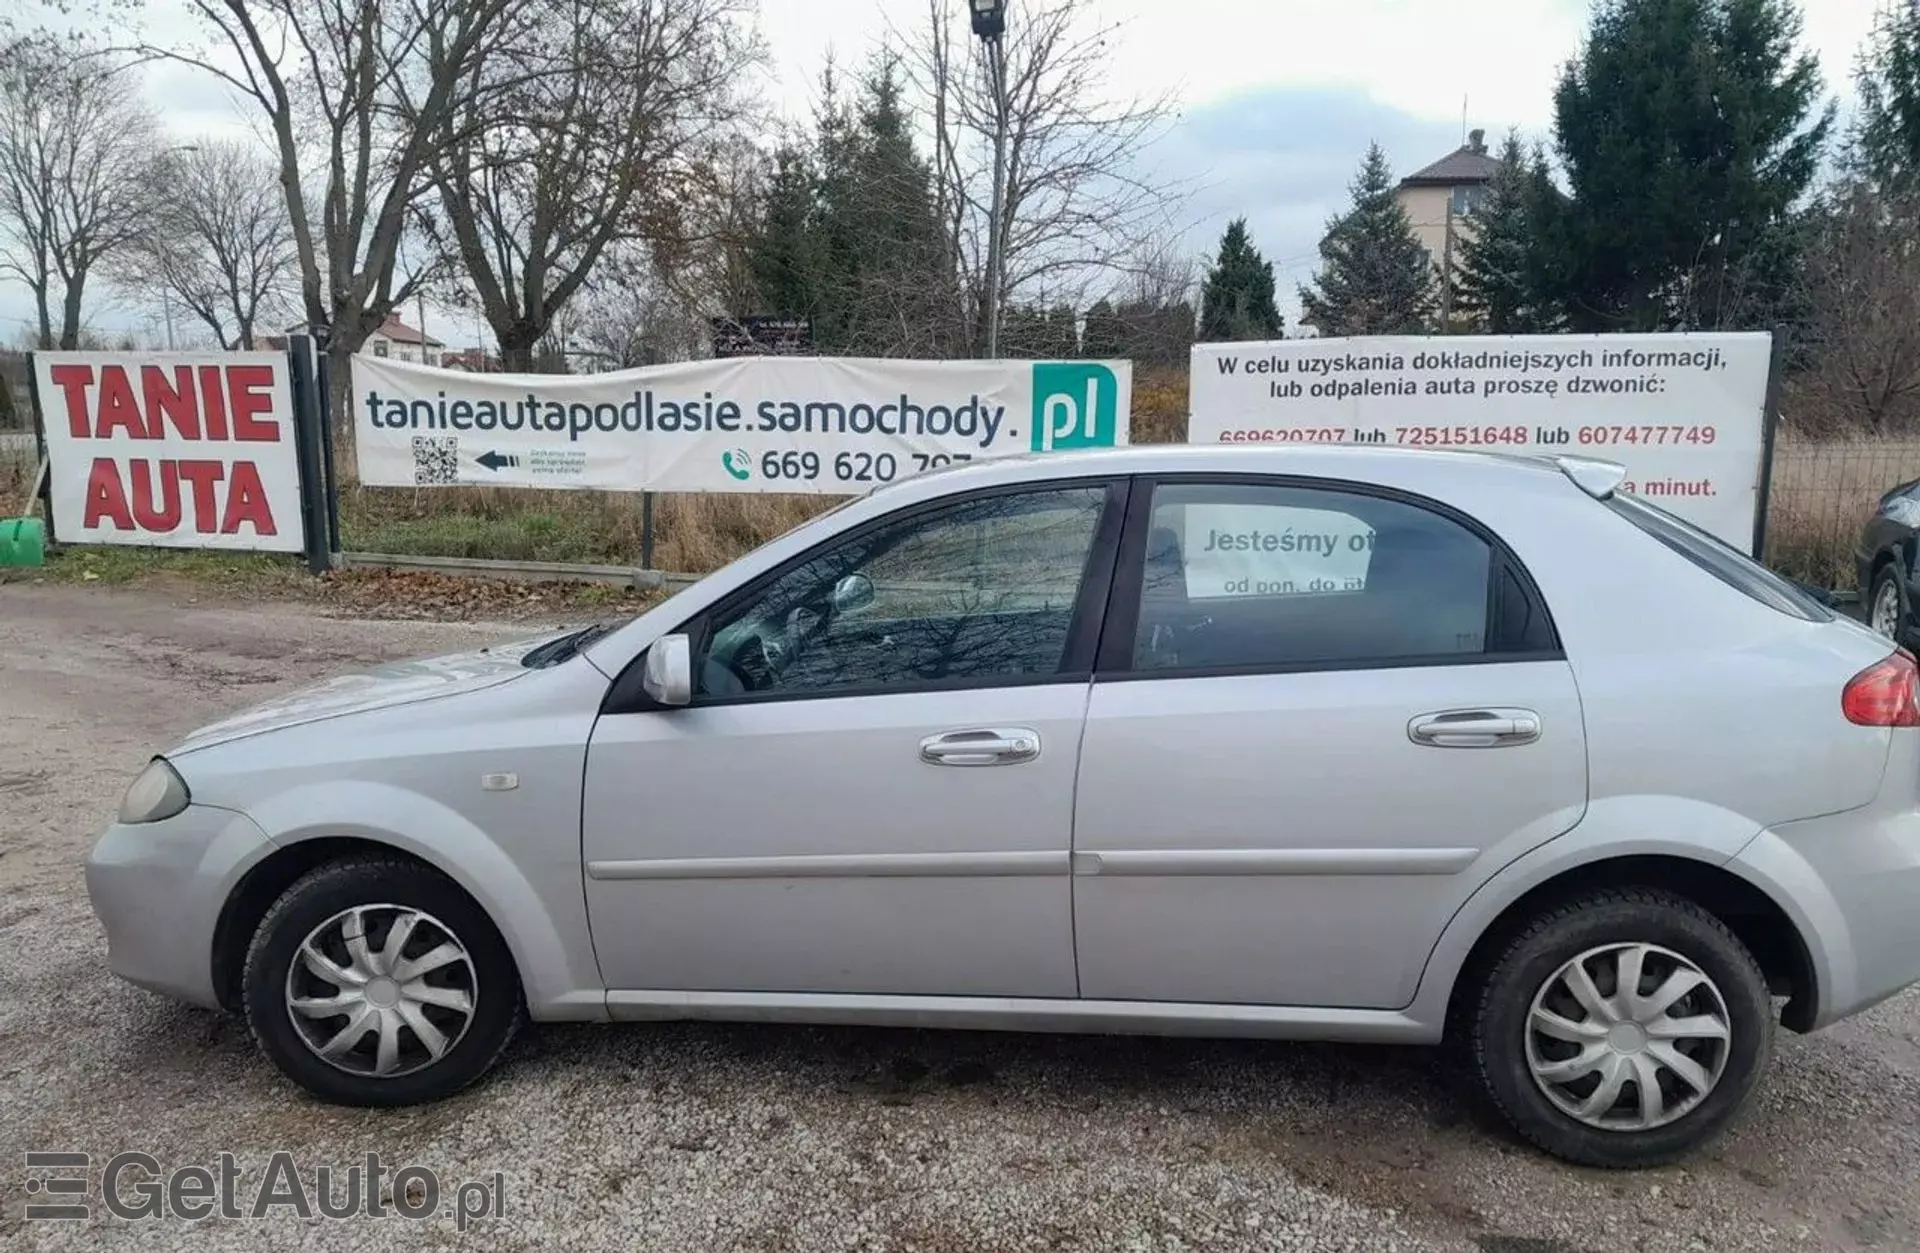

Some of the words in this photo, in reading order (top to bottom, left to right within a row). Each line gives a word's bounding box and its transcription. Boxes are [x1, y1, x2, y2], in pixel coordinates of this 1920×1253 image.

[1217, 356, 1238, 375] W
[1244, 354, 1289, 374] celu
[1297, 353, 1405, 376] uzyskania
[1412, 350, 1592, 373] dokładniejszych
[1601, 346, 1727, 372] informacji,
[1269, 379, 1303, 399] lub
[1310, 378, 1417, 399] odpalenia
[1424, 377, 1476, 396] auta
[1482, 376, 1558, 398] proszę
[1566, 373, 1666, 395] dzwonić:
[50, 364, 281, 442] TANIE
[1395, 426, 1528, 446] 725151648
[1535, 425, 1570, 445] lub
[1577, 425, 1717, 445] 607477749
[760, 450, 820, 480] 669
[834, 451, 896, 482] 620
[83, 457, 278, 537] AUTA
[1644, 477, 1717, 496] minut.
[1204, 527, 1339, 557] Jesteśmy
[1223, 578, 1249, 593] od
[1309, 576, 1335, 592] do
